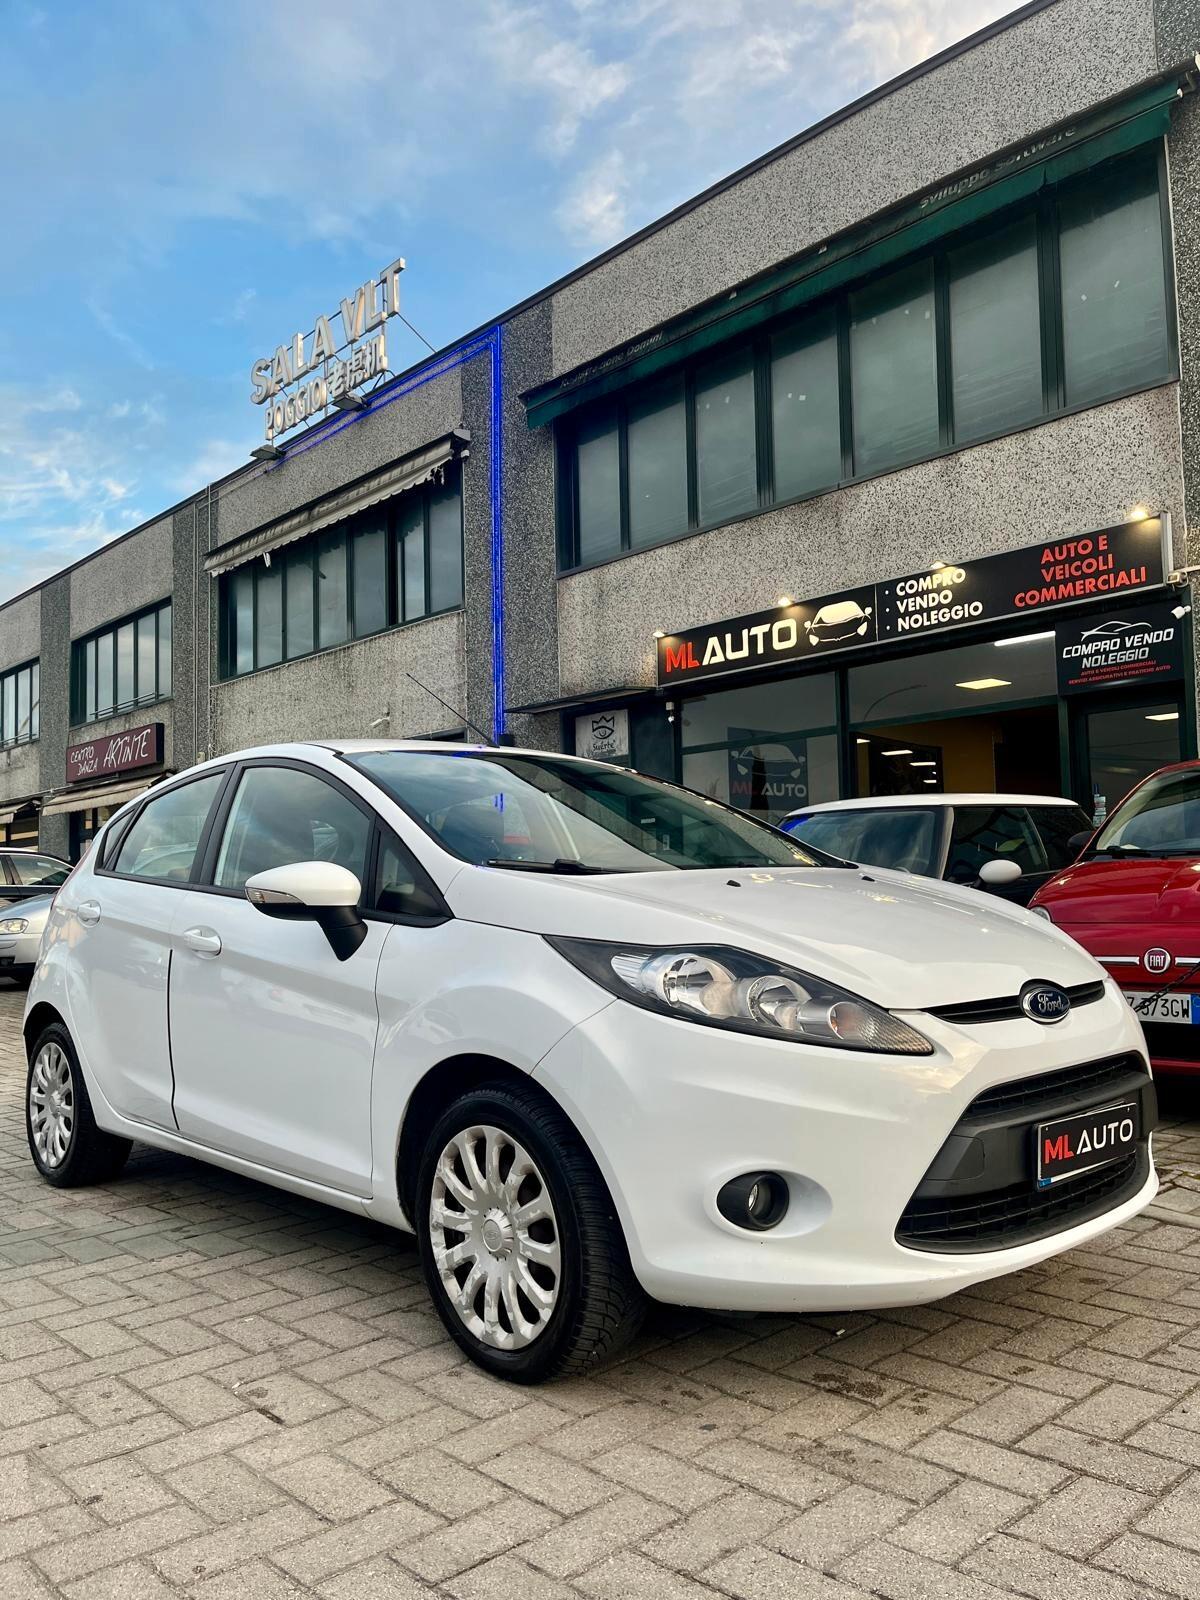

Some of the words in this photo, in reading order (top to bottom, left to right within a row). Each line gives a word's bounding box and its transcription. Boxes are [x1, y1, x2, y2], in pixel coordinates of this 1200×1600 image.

[250, 315, 335, 405] SALA
[340, 257, 406, 344] VLT
[265, 376, 328, 441] POGGIO
[326, 334, 388, 399] 老虎机
[1041, 539, 1093, 564] AUTO
[1098, 535, 1108, 551] E
[896, 567, 966, 596] COMPRO
[1041, 553, 1113, 583] VEICOLI
[896, 589, 953, 614] VENDO
[1014, 566, 1147, 608] COMMERCIALI
[897, 601, 983, 632] NOLEGGIO
[666, 641, 700, 673] ML
[702, 618, 797, 666] AUTO
[1063, 638, 1121, 659] COMPRO
[1125, 627, 1175, 647] VENDO
[1080, 668, 1095, 676] AUTO
[1100, 665, 1120, 674] VEICOLI
[1120, 660, 1157, 671] COMMERCIALI
[1082, 647, 1150, 669] NOLEGGIO
[1155, 664, 1171, 672] AUTO
[70, 745, 95, 764] CENTRO
[77, 758, 98, 776] DANZA
[731, 781, 761, 797] ML
[761, 782, 807, 798] AUTO
[1149, 954, 1165, 968] FIAT
[1037, 992, 1064, 1013] Ford
[1044, 1134, 1074, 1164] ML
[1076, 1118, 1133, 1155] AUTO
